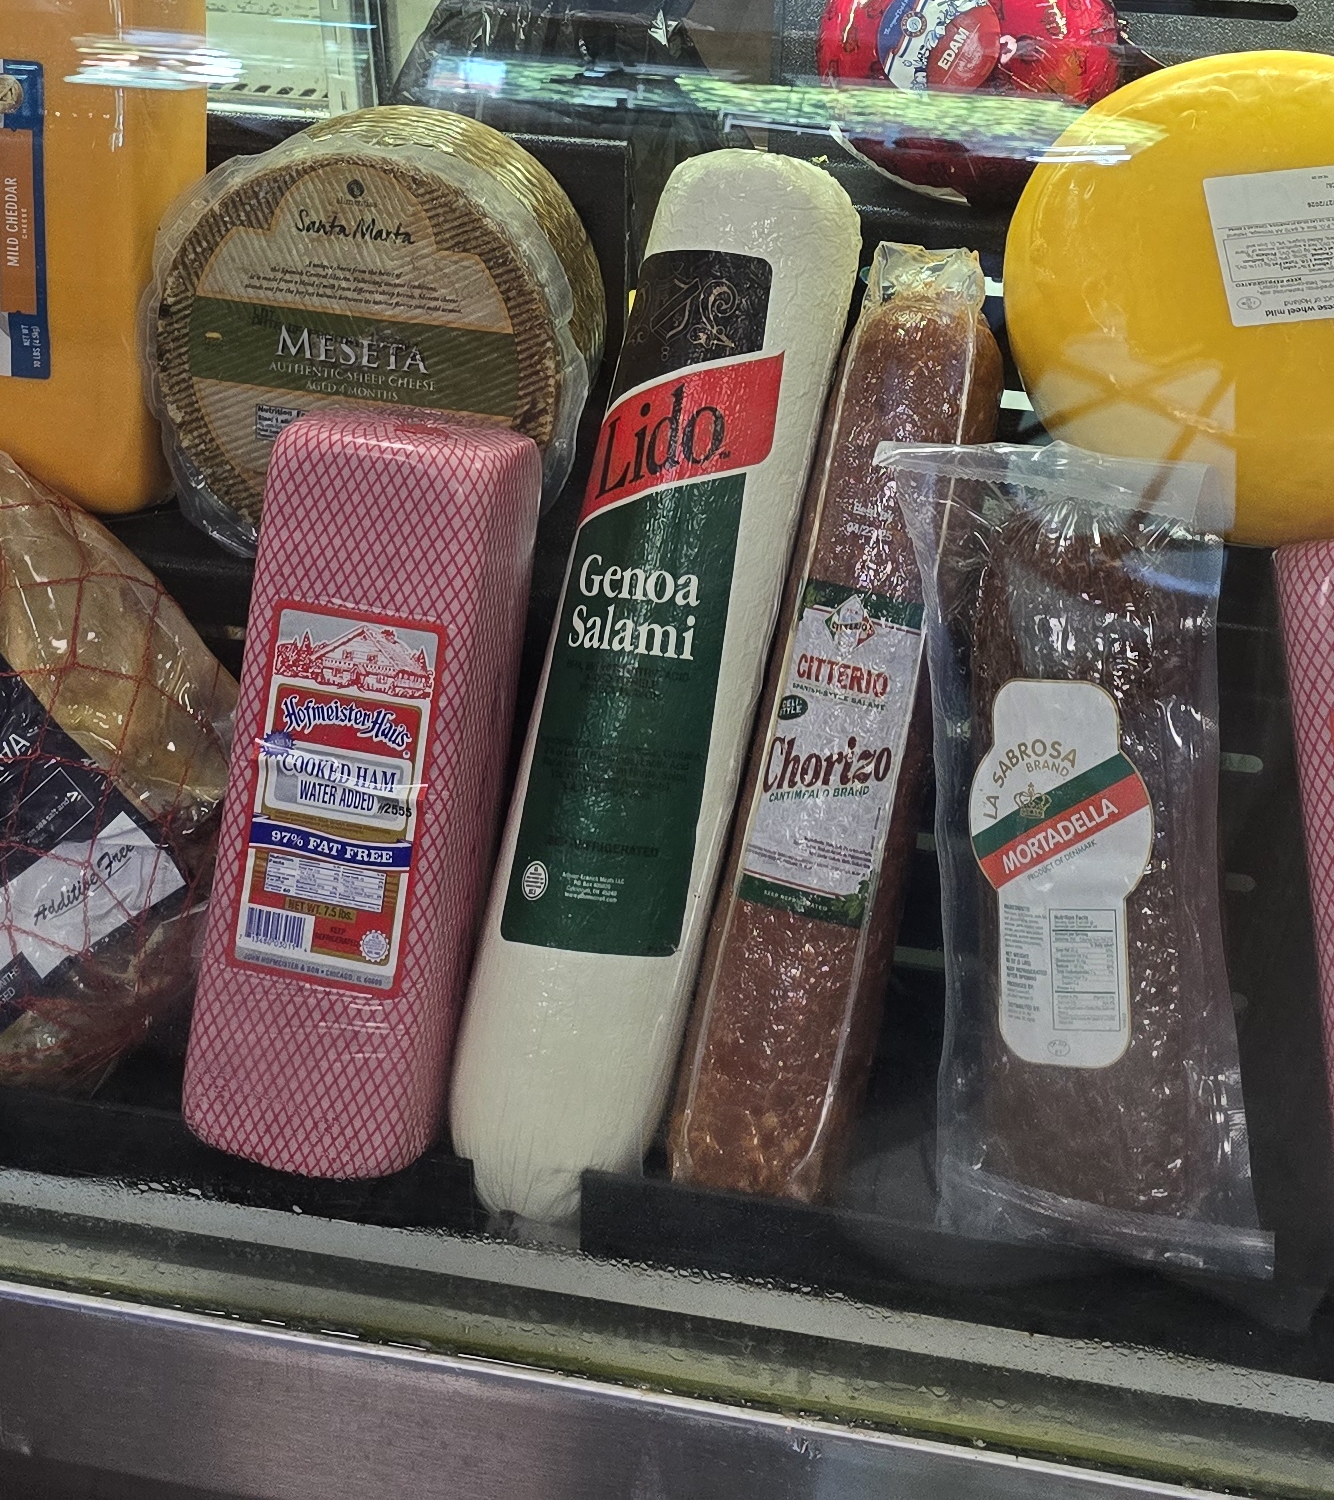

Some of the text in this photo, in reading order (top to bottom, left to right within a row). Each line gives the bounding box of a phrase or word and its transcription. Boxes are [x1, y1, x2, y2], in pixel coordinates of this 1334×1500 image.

[938, 27, 970, 70] EDAM
[5, 177, 19, 267] MILD CHEDDAR
[294, 209, 416, 245] Santa Marta
[1265, 309, 1286, 317] mild
[1288, 304, 1316, 315] wheel
[275, 324, 429, 374] MESETA
[268, 362, 436, 391] AUTHENTIC SHEEP CHEESE
[348, 386, 398, 401] MONTHS
[258, 405, 293, 416] Nutrition
[594, 383, 725, 500] Lido
[579, 554, 700, 607] Genoa
[568, 602, 696, 661] Salami
[796, 653, 889, 697] CITTERIO
[281, 695, 371, 737] Hofmeister
[281, 752, 397, 792] COOKED HAM
[762, 736, 892, 794] Chorizo
[984, 738, 1078, 820] LA SABROSA
[1025, 760, 1070, 778] BRAND
[300, 779, 337, 806] WATER
[339, 787, 375, 812] ADDED
[832, 785, 870, 798] BRAND
[270, 829, 393, 864] 97% FAT FREE
[1001, 797, 1120, 875] MORTADELLA
[32, 842, 136, 926] Additive Free
[323, 905, 354, 921] 7.5 lbs.
